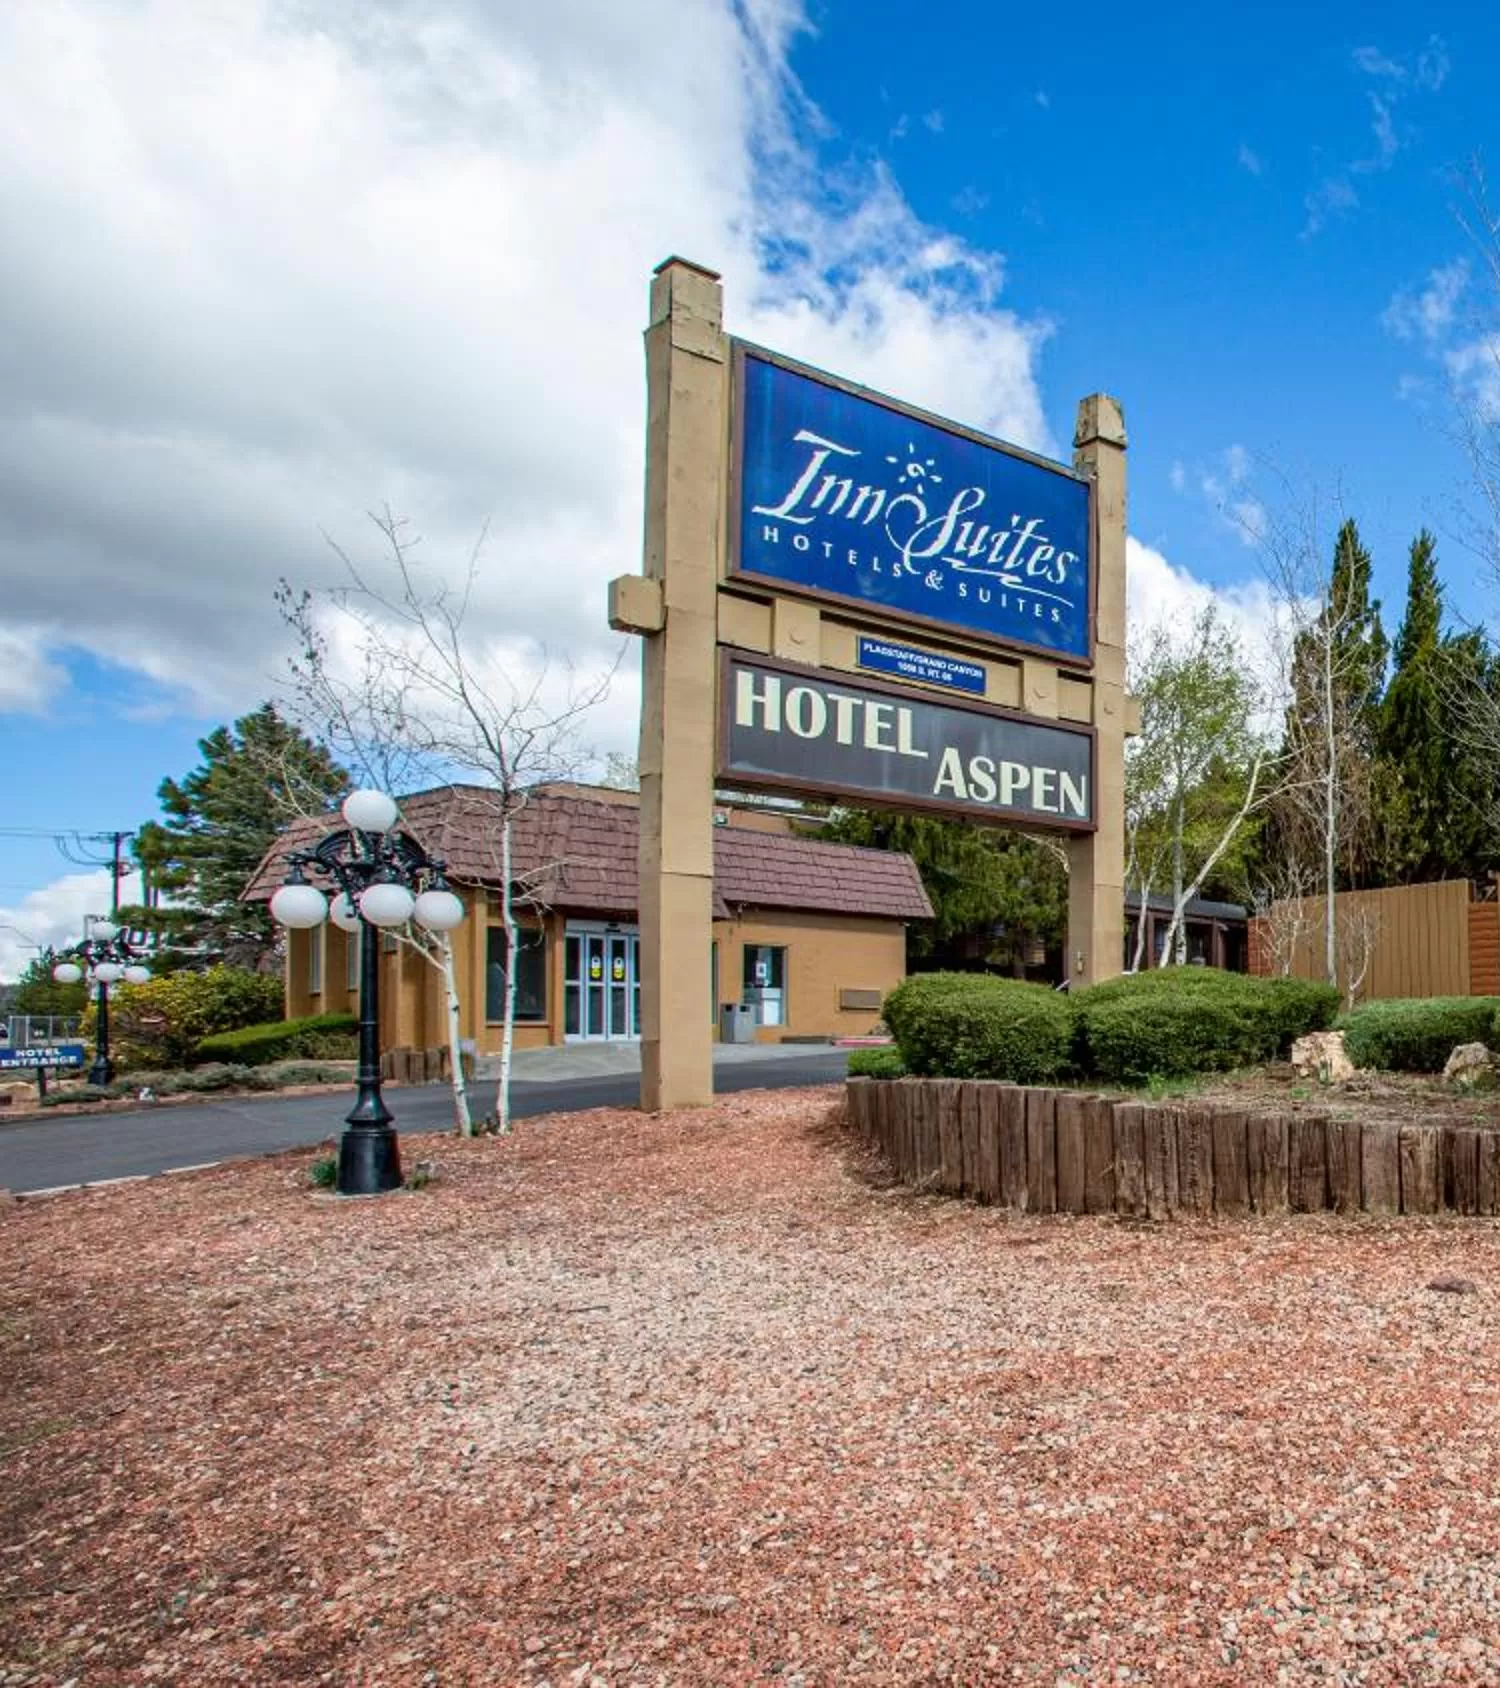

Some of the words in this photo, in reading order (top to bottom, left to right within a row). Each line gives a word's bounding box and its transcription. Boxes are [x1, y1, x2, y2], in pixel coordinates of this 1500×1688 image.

[762, 525, 902, 578] HOTELS
[924, 570, 944, 591] &
[958, 581, 1061, 623] SUITES
[735, 670, 929, 759] HOTEL
[933, 746, 1087, 816] ASPEN
[1, 1055, 77, 1067] ENTRANCE
[15, 1047, 61, 1057] HOTEL
